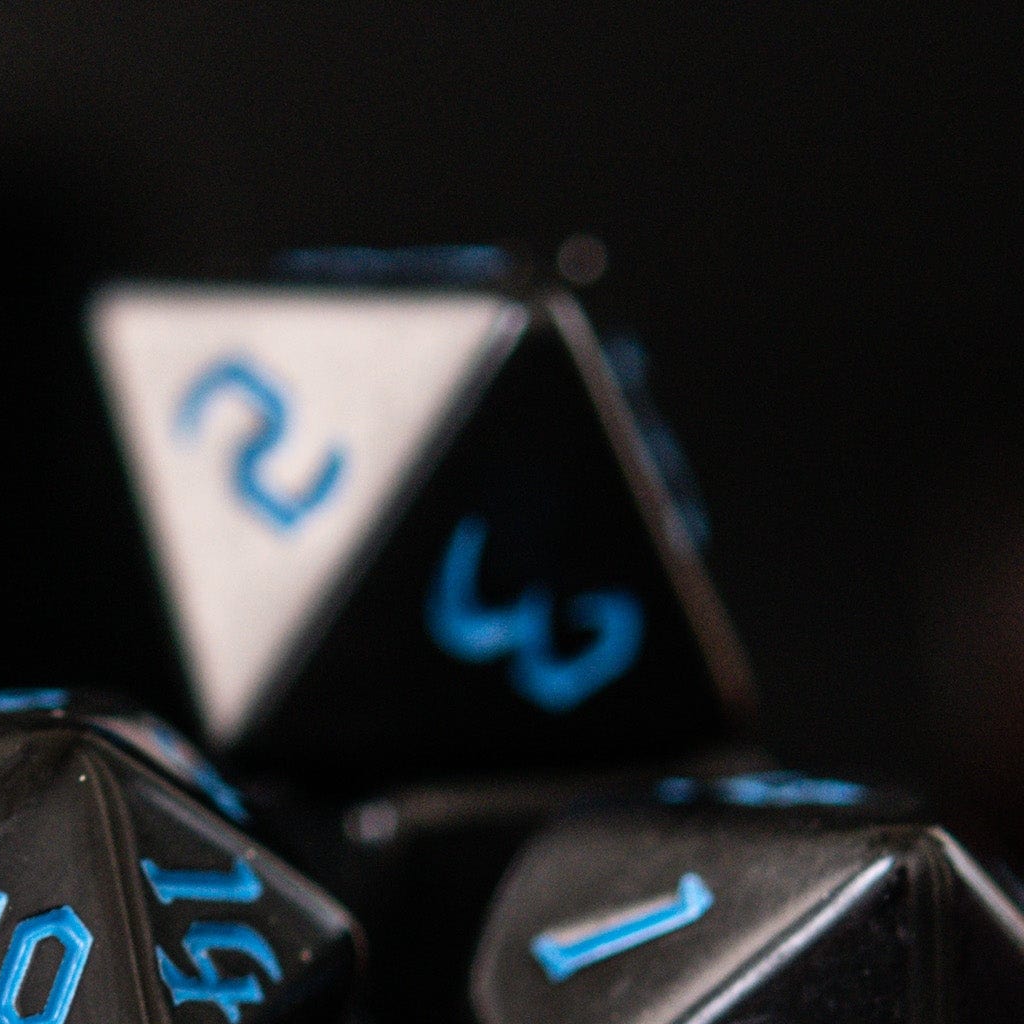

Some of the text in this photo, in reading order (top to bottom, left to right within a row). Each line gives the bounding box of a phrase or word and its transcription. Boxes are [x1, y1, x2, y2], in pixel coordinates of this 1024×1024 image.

[178, 357, 346, 536] 2
[426, 516, 646, 712] 3
[535, 878, 712, 979] 1
